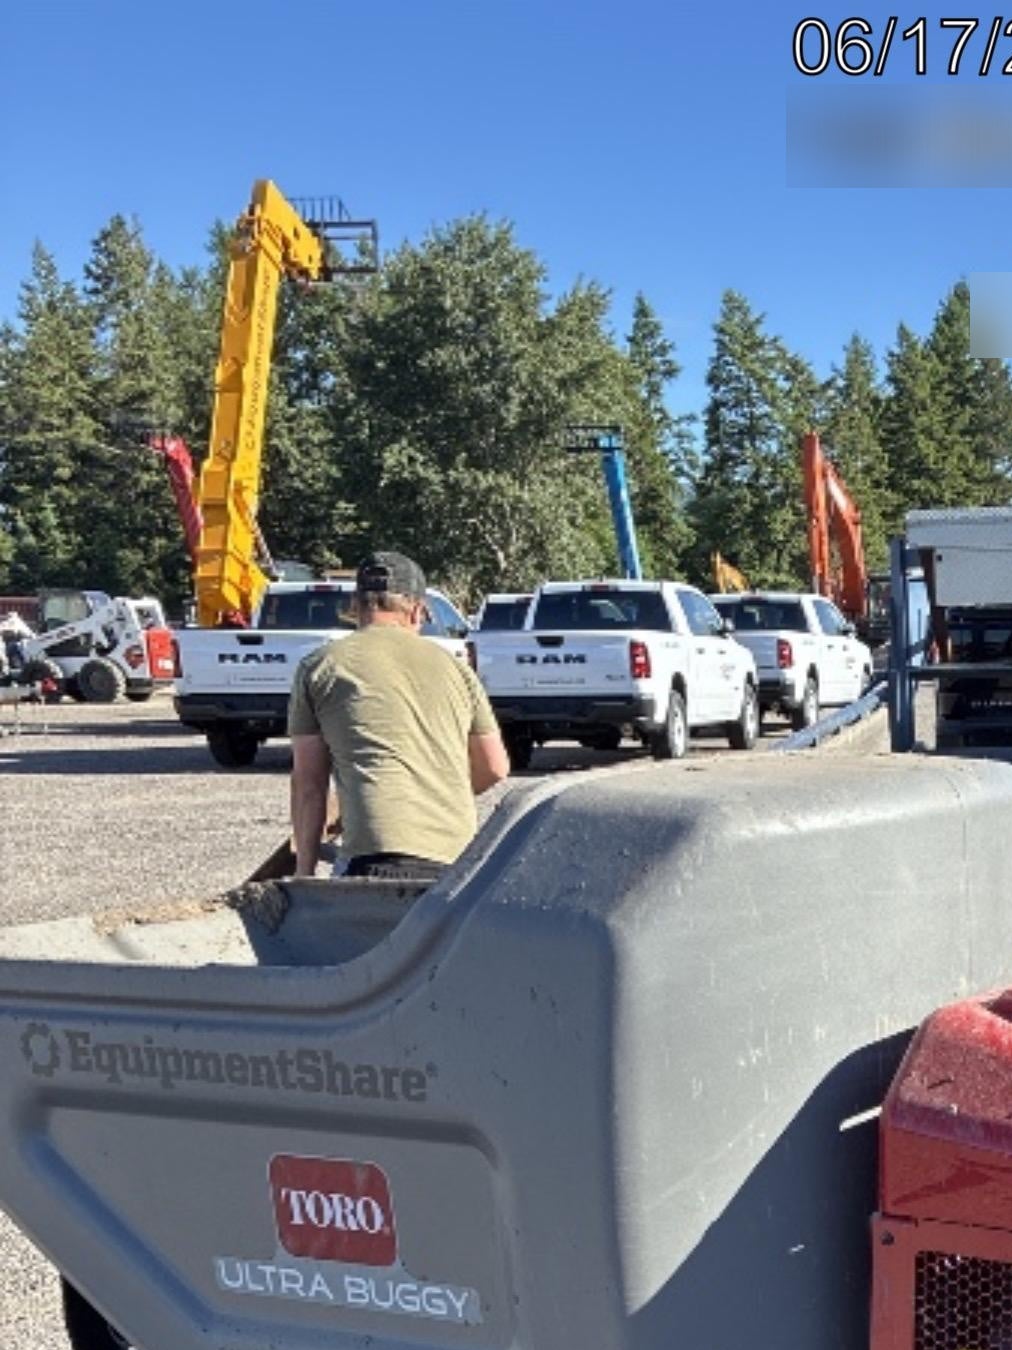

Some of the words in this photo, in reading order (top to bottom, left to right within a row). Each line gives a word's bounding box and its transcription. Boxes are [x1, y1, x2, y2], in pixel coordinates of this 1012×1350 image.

[218, 653, 288, 664] RAM
[516, 653, 587, 664] RAM
[281, 1188, 385, 1235] TORO
[217, 1259, 334, 1300] ULTRA
[344, 1275, 470, 1318] BUGGY
